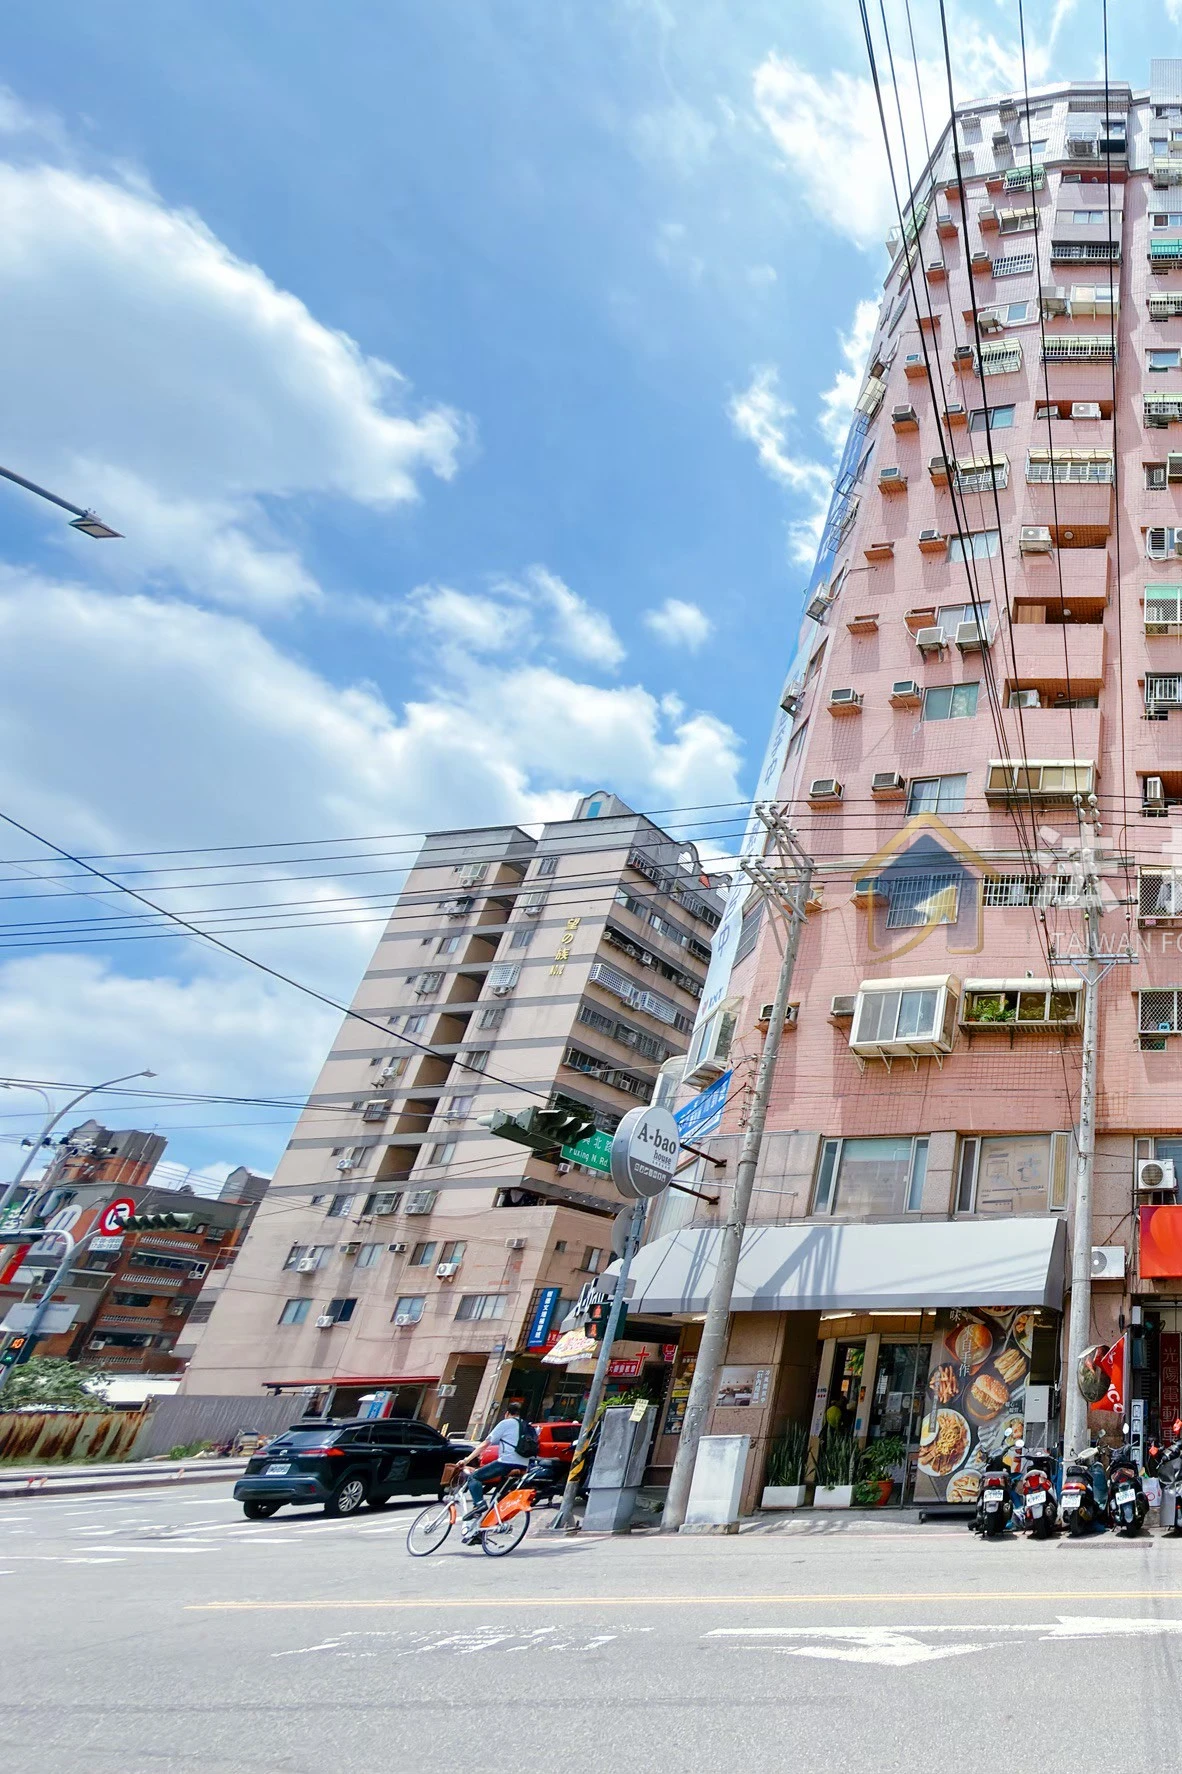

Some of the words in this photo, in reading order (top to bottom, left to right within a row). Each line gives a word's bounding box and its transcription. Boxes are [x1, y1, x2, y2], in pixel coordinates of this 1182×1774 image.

[637, 1122, 677, 1155] A-bao
[599, 1156, 609, 1167] Rd.
[653, 1149, 672, 1165] house
